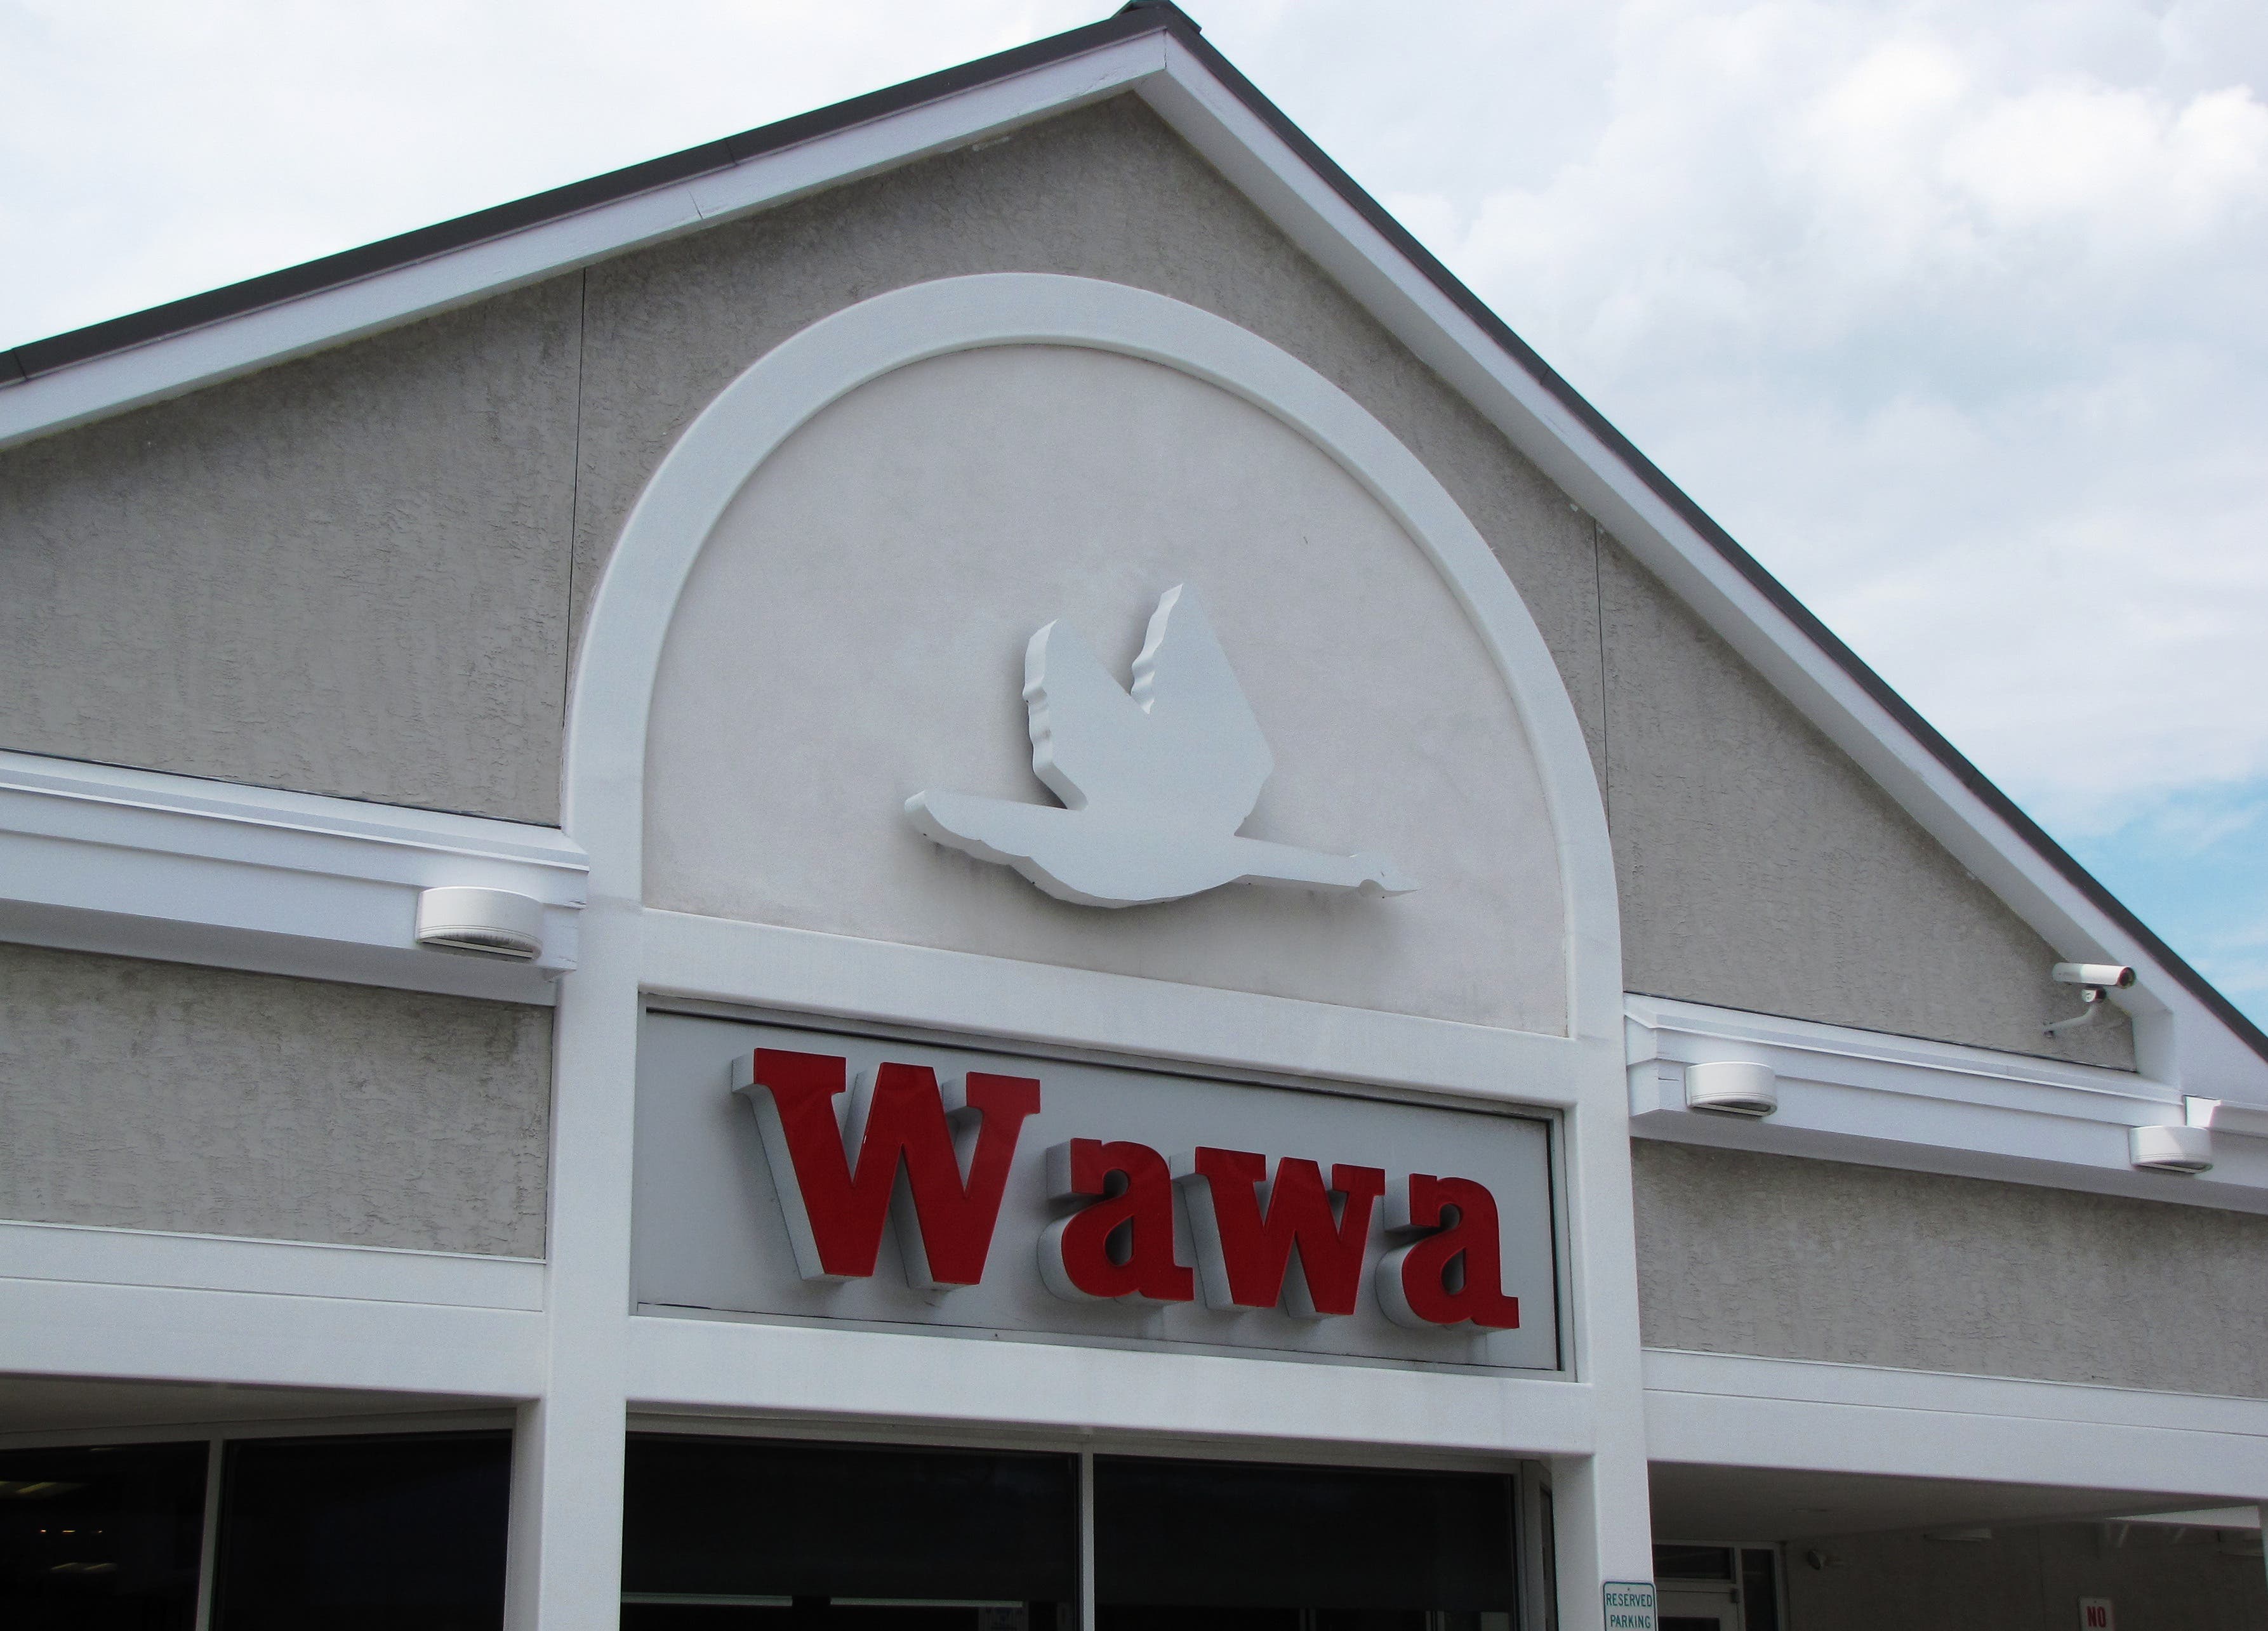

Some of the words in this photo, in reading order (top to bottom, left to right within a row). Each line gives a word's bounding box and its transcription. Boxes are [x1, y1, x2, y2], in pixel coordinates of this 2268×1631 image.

[753, 1047, 1520, 1330] Wawa
[1606, 1593, 1653, 1607] RESERVED
[1610, 1614, 1651, 1628] PARKING
[2086, 1606, 2107, 1628] NO
